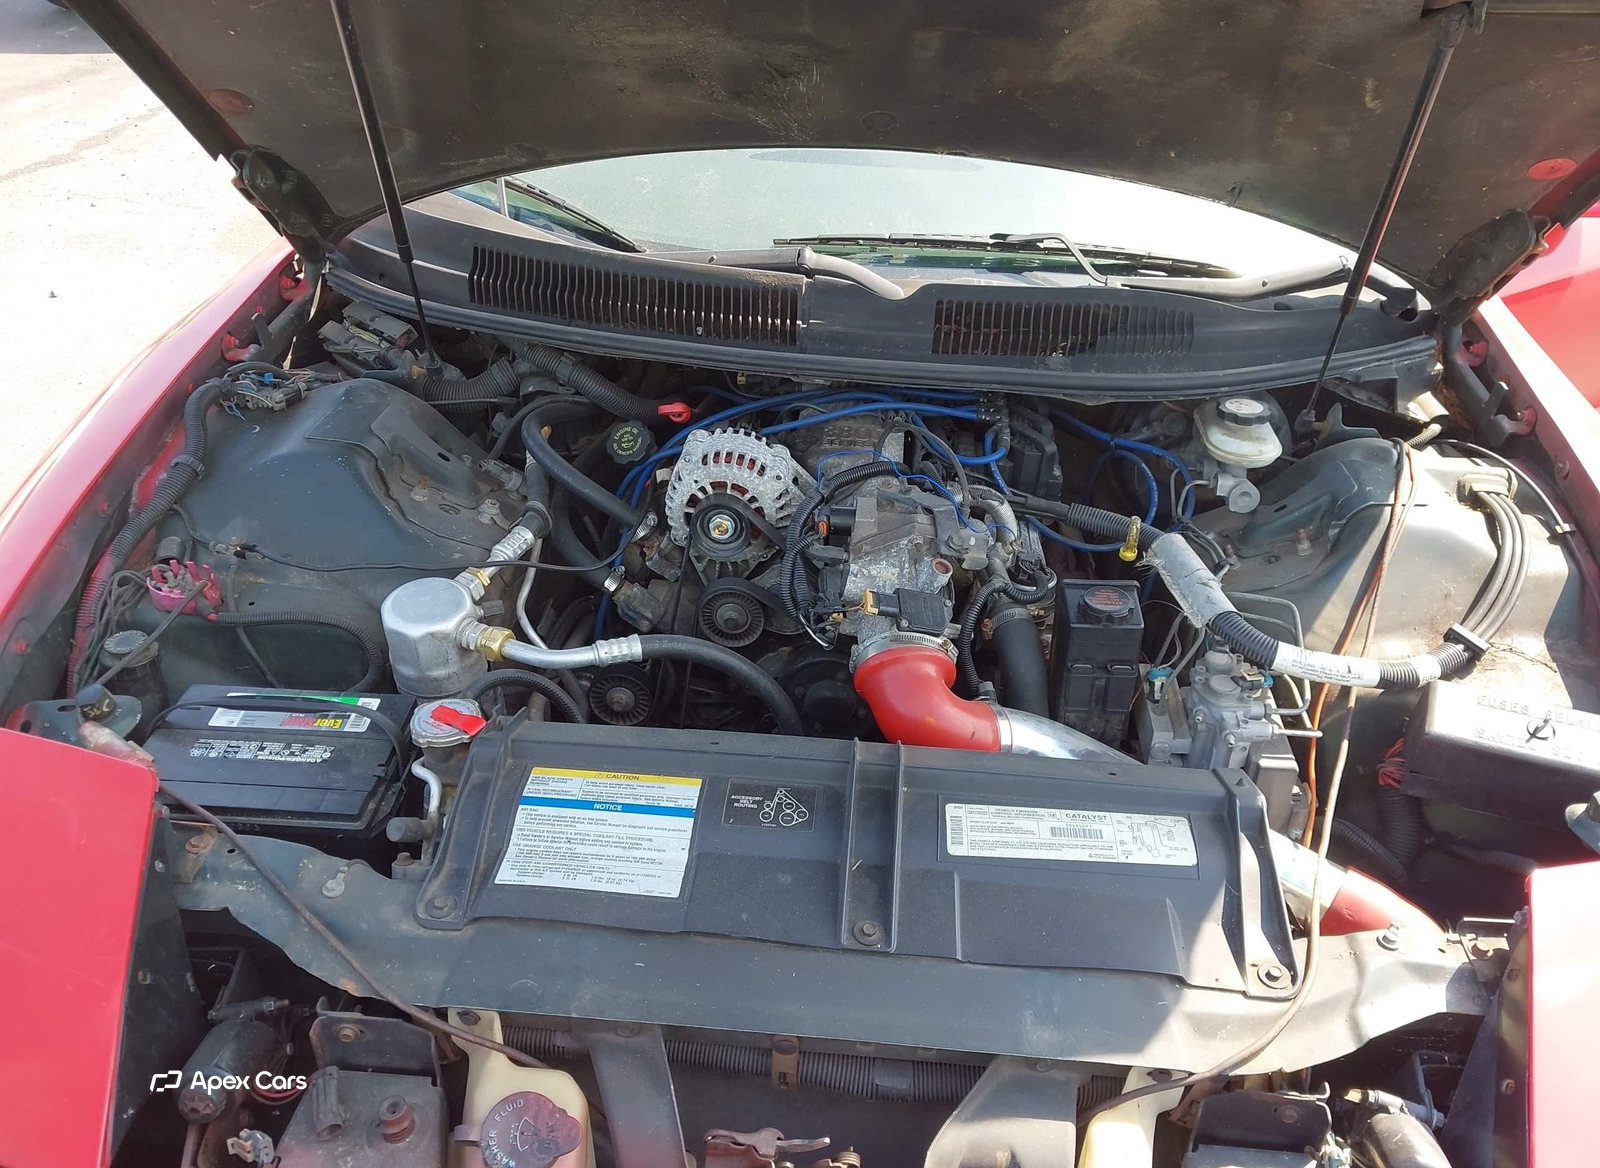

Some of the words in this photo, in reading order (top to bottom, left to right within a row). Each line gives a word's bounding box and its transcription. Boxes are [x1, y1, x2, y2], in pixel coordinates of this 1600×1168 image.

[614, 427, 631, 440] ENGINE
[1422, 673, 1438, 684] FUEL
[1477, 695, 1529, 716] FUSES
[494, 1099, 524, 1122] FLUID
[488, 1130, 516, 1168] WASHER
